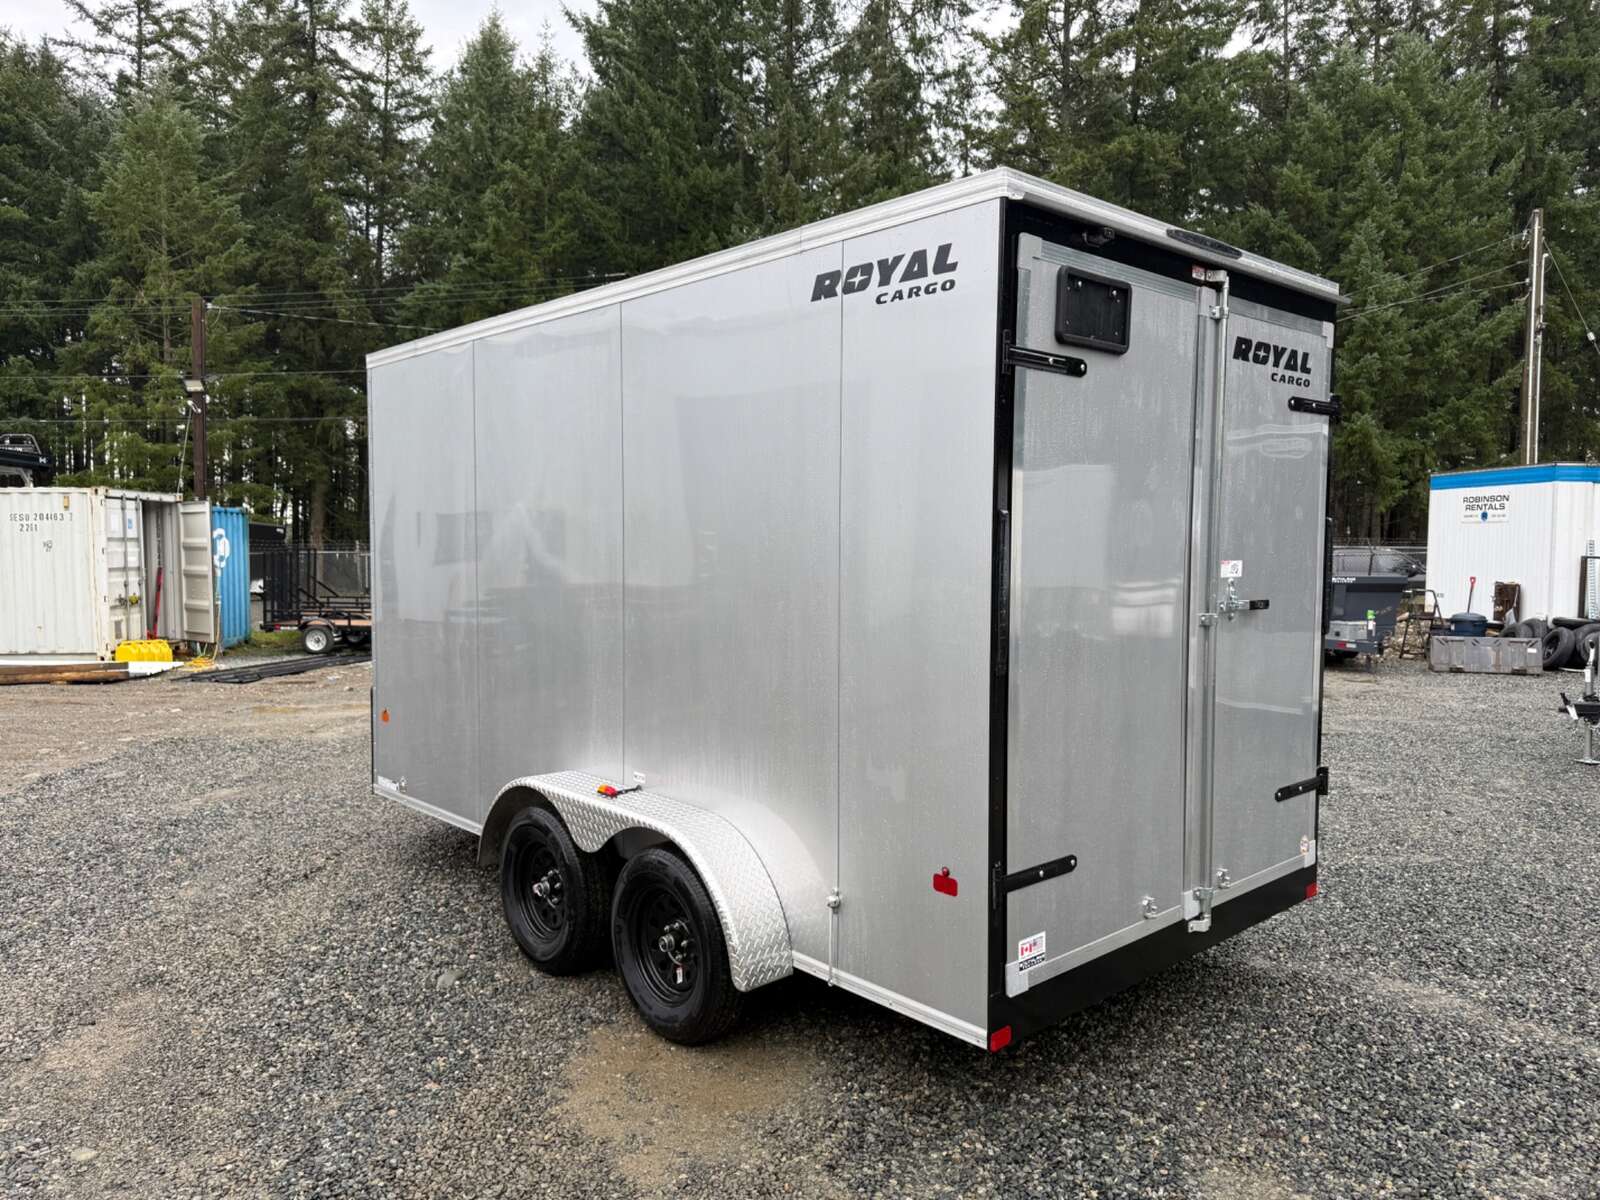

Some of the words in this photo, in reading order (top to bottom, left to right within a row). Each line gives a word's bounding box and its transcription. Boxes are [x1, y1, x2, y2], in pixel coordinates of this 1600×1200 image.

[811, 243, 958, 302] ROYAL
[875, 279, 956, 305] CARGO
[1233, 336, 1312, 375] ROYAL
[1271, 372, 1311, 388] CARGO
[1463, 495, 1510, 504] ROBINSON
[1465, 503, 1506, 511] RENTALS
